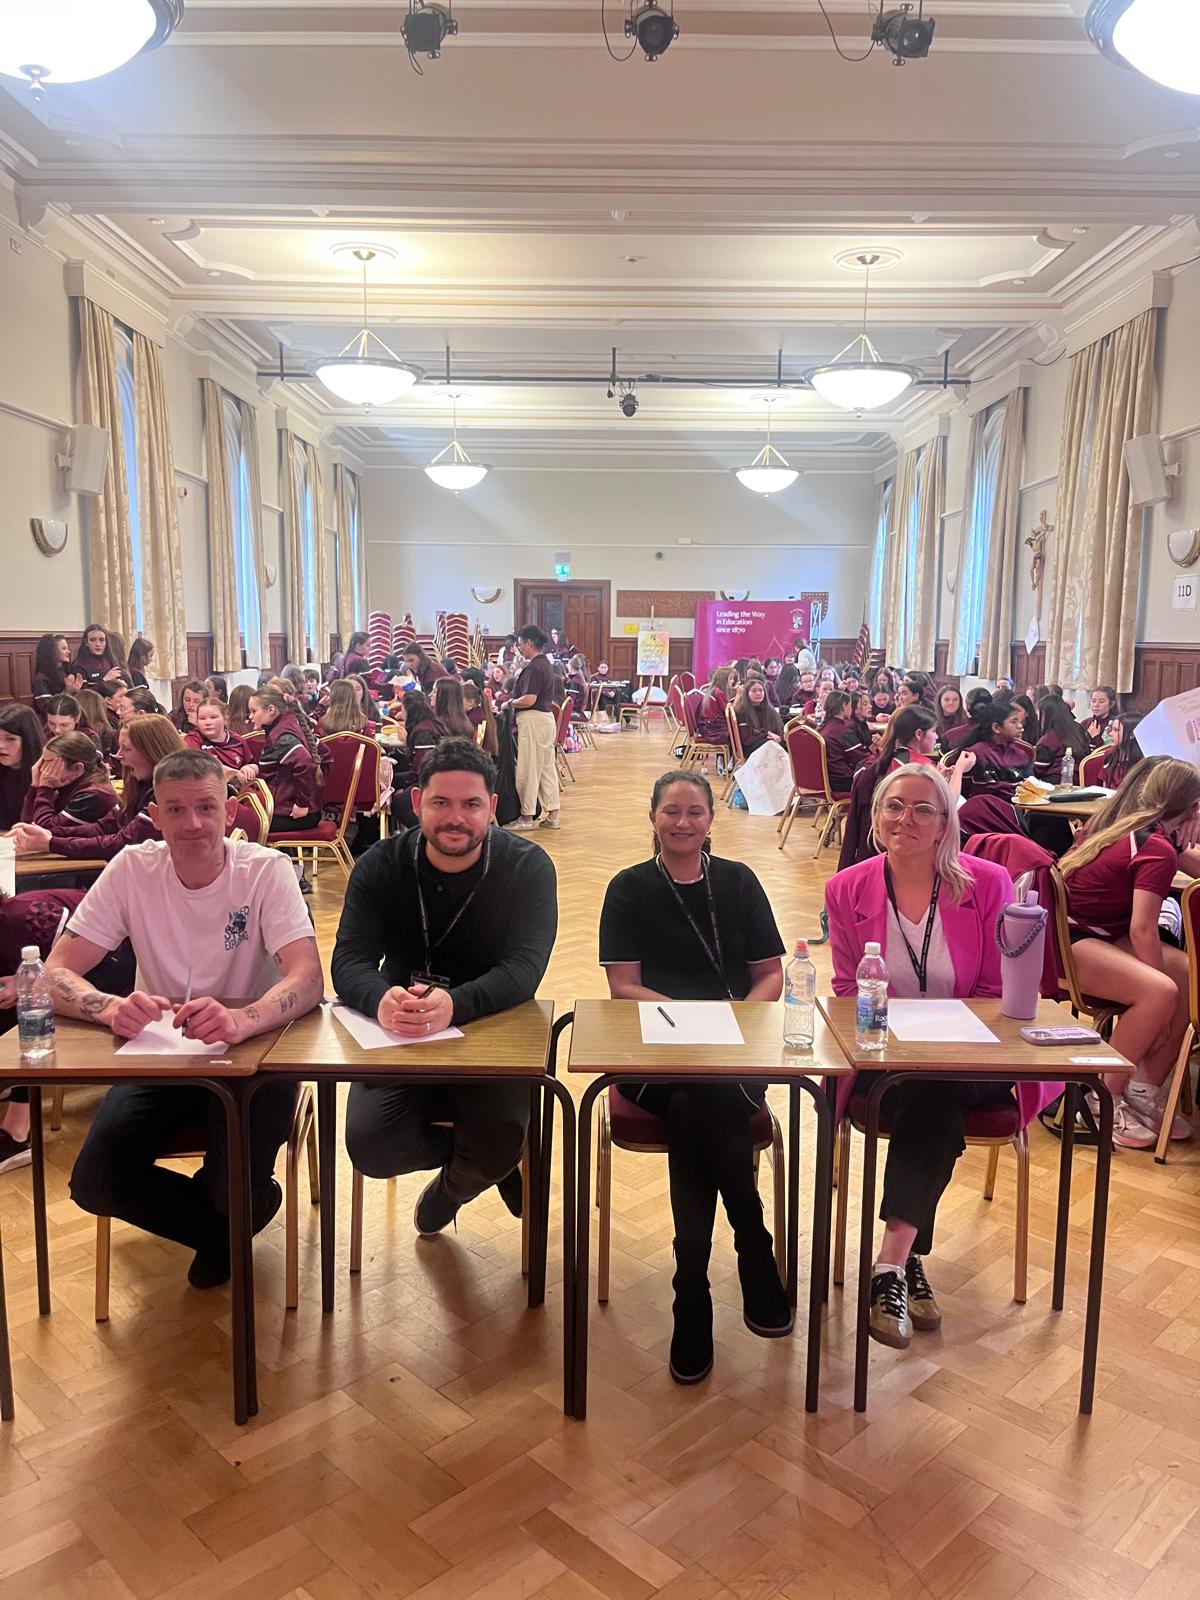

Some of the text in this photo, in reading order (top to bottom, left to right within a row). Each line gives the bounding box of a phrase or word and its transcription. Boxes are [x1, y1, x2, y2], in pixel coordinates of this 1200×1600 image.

[1178, 584, 1192, 597] 11D
[716, 611, 739, 619] Leading
[752, 611, 765, 620] Way
